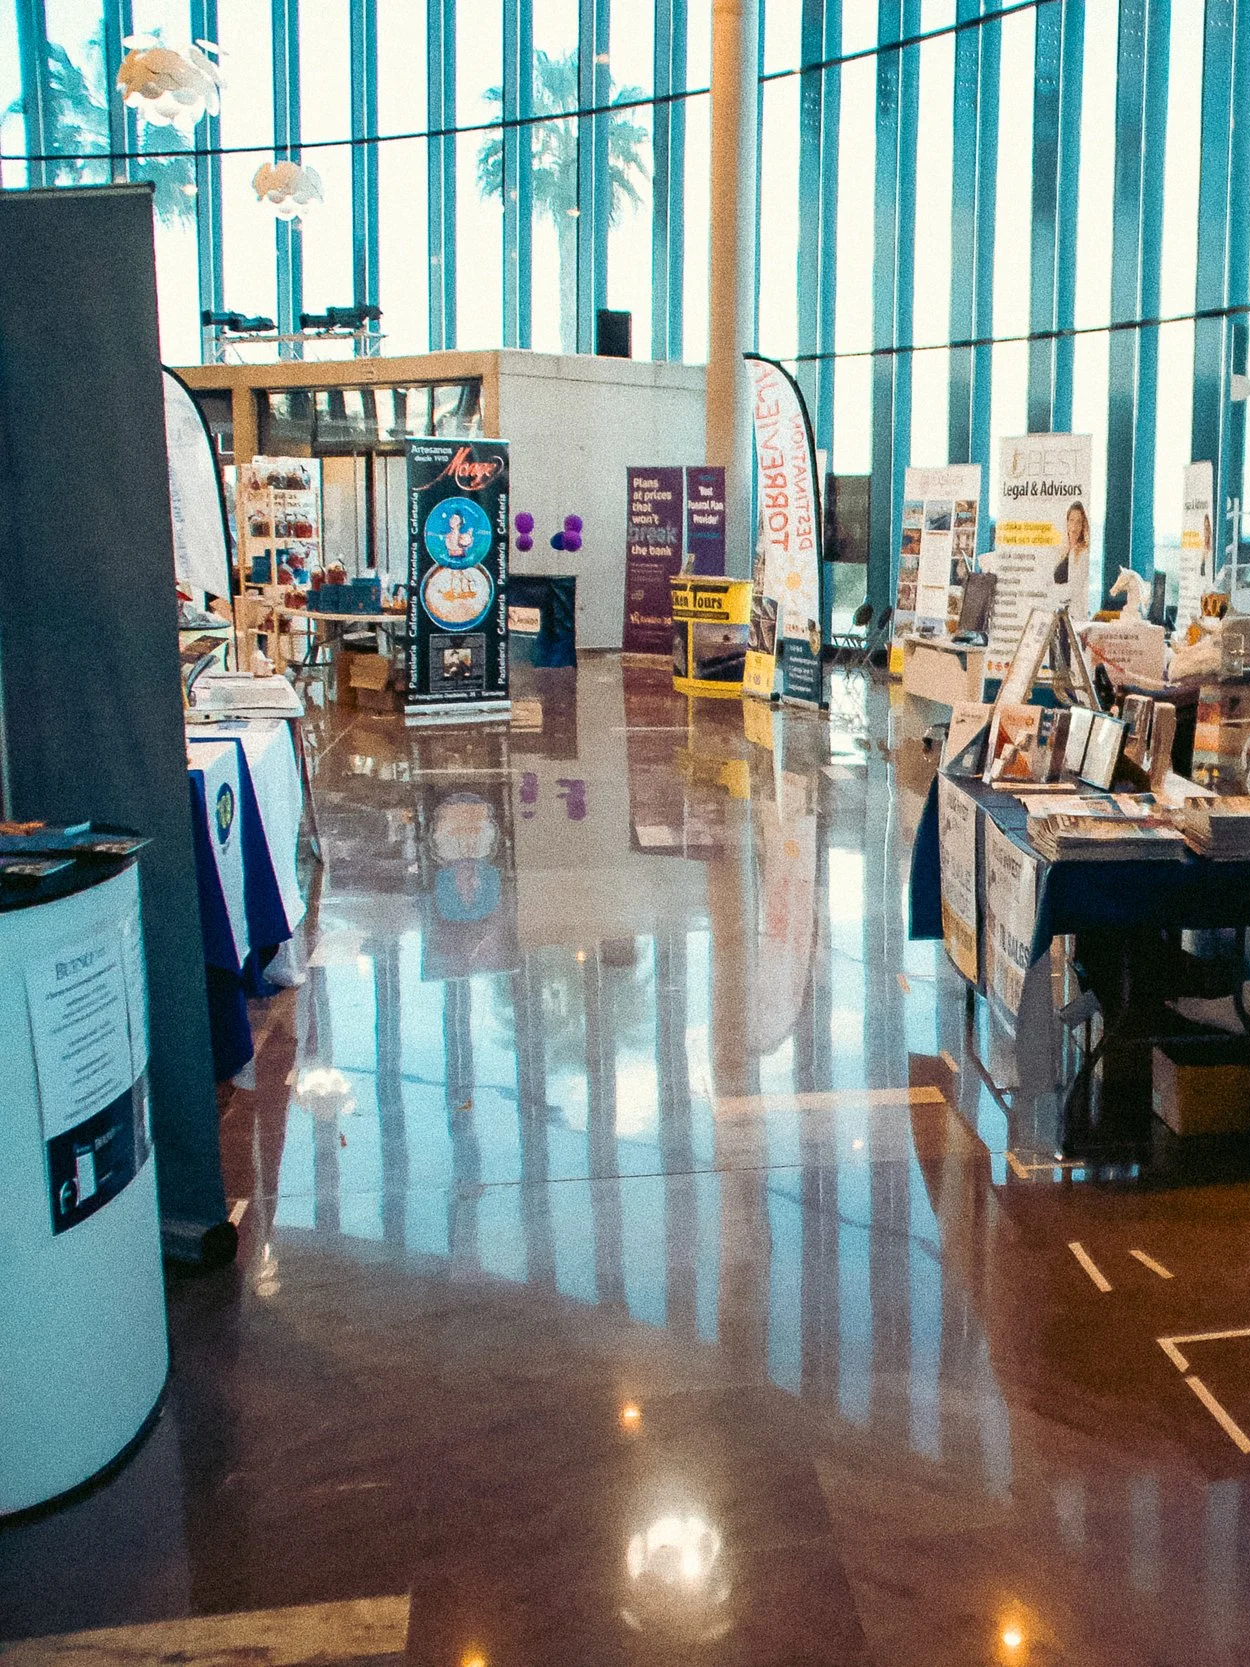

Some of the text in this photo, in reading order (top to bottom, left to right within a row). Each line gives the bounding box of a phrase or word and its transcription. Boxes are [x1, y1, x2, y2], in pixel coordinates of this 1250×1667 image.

[633, 478, 659, 489] Plans
[633, 490, 672, 502] at prices
[1003, 480, 1083, 501] Legal & Advisors
[632, 502, 653, 513] that
[632, 513, 660, 525] won't
[628, 521, 677, 545] break
[631, 544, 673, 557] the bank
[691, 585, 723, 609] Tours
